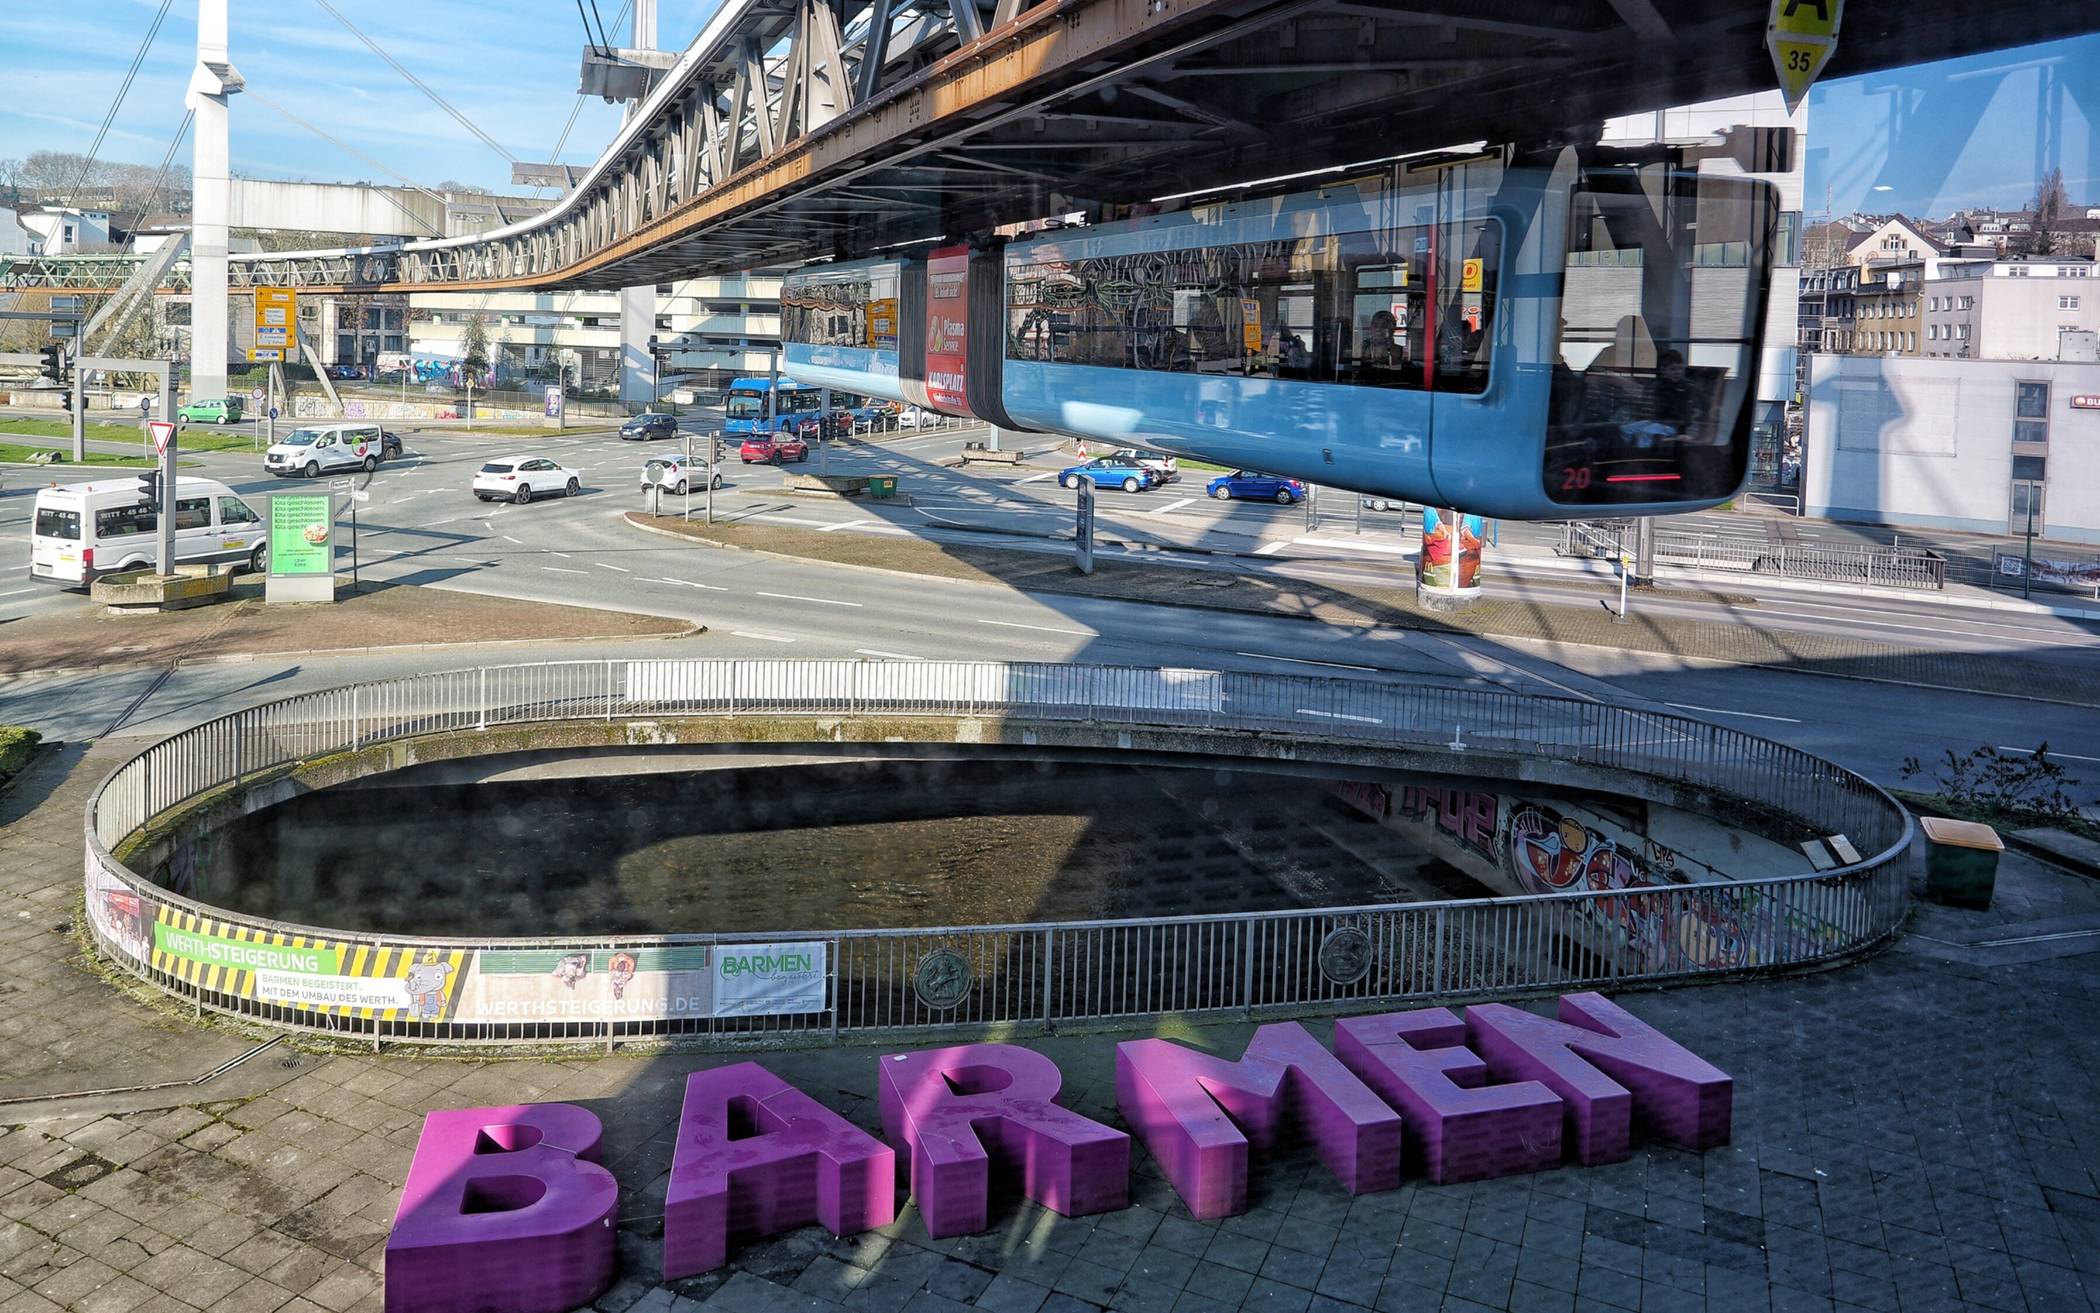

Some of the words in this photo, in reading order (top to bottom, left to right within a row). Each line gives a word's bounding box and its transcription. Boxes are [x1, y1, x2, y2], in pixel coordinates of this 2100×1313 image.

[1788, 50, 1811, 72] 35
[944, 319, 965, 336] Plasma
[928, 372, 964, 392] KARLSPLATZ
[1562, 467, 1591, 490] 20
[165, 931, 319, 972] WERTHSTEIGERUNG
[721, 954, 811, 974] BARMEN
[262, 974, 300, 987] BARMEN
[302, 978, 362, 992] BEGEISTERT.
[262, 986, 279, 998] MIT
[280, 988, 300, 1000] DEM
[301, 991, 336, 1003] UMBAU
[338, 994, 358, 1004] DES
[359, 995, 400, 1005] WERTH.
[477, 997, 700, 1017] WERTHSTEIGERUNG.DE
[385, 990, 1733, 1313] BARMEN
